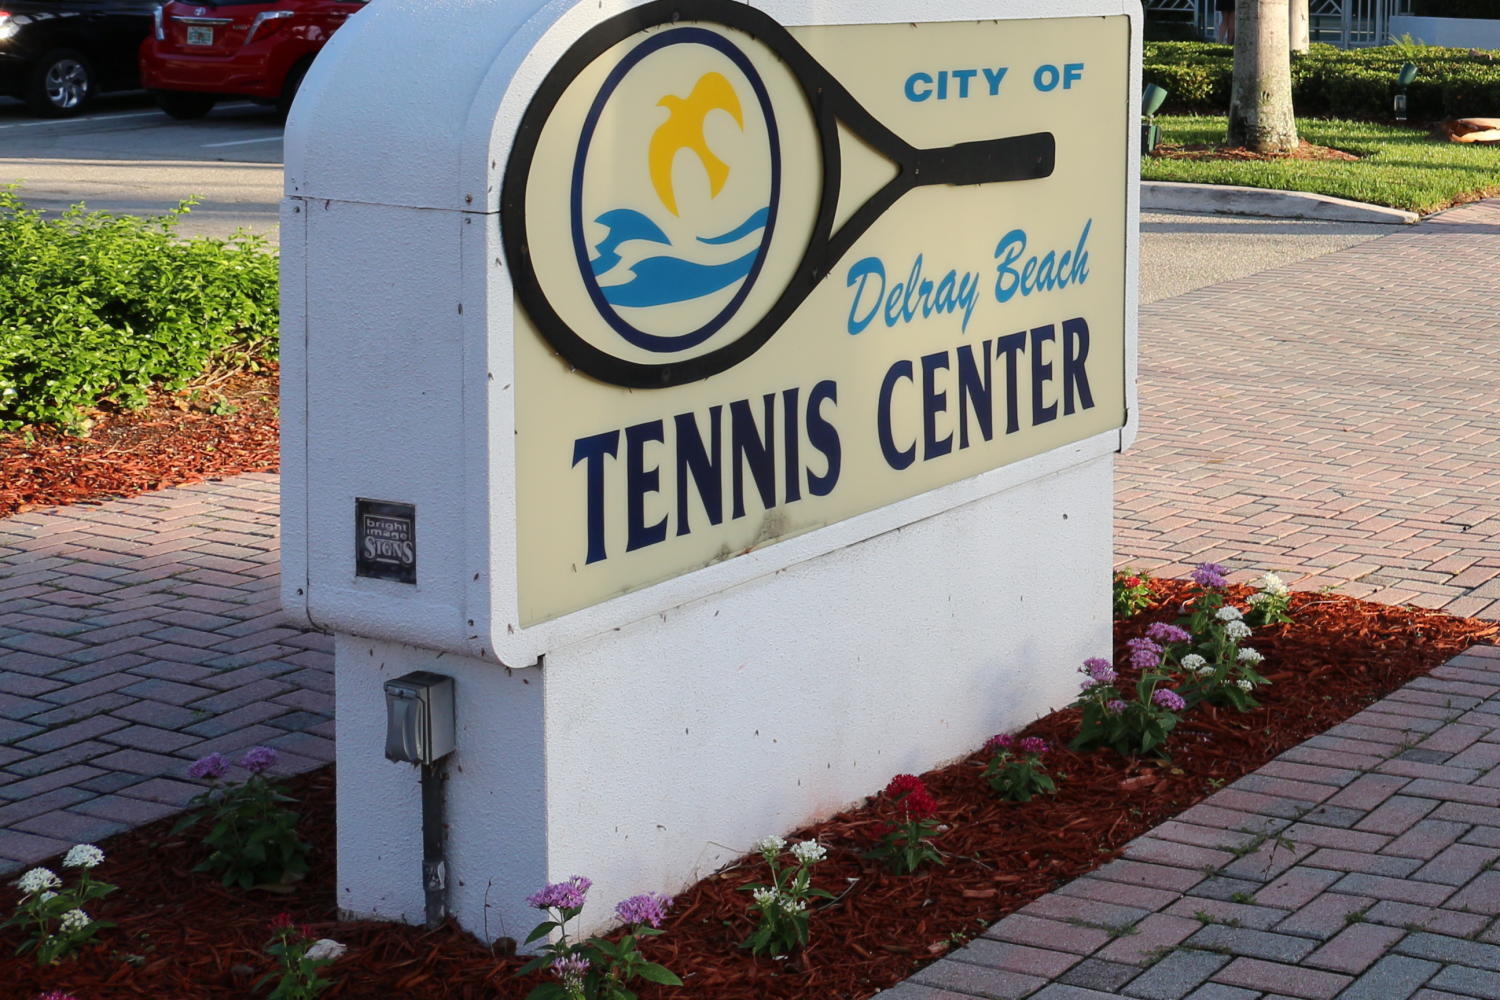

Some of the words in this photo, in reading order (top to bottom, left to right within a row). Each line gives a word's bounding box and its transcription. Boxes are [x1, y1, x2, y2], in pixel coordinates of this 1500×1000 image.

[904, 66, 1009, 103] CITY
[1033, 62, 1085, 93] OF
[846, 252, 980, 337] Delray
[993, 217, 1093, 303] Beach
[571, 379, 842, 566] TENNIS
[877, 316, 1096, 471] CENTER
[366, 518, 407, 532] bright
[366, 528, 408, 540] image
[364, 535, 414, 564] SIGNS
